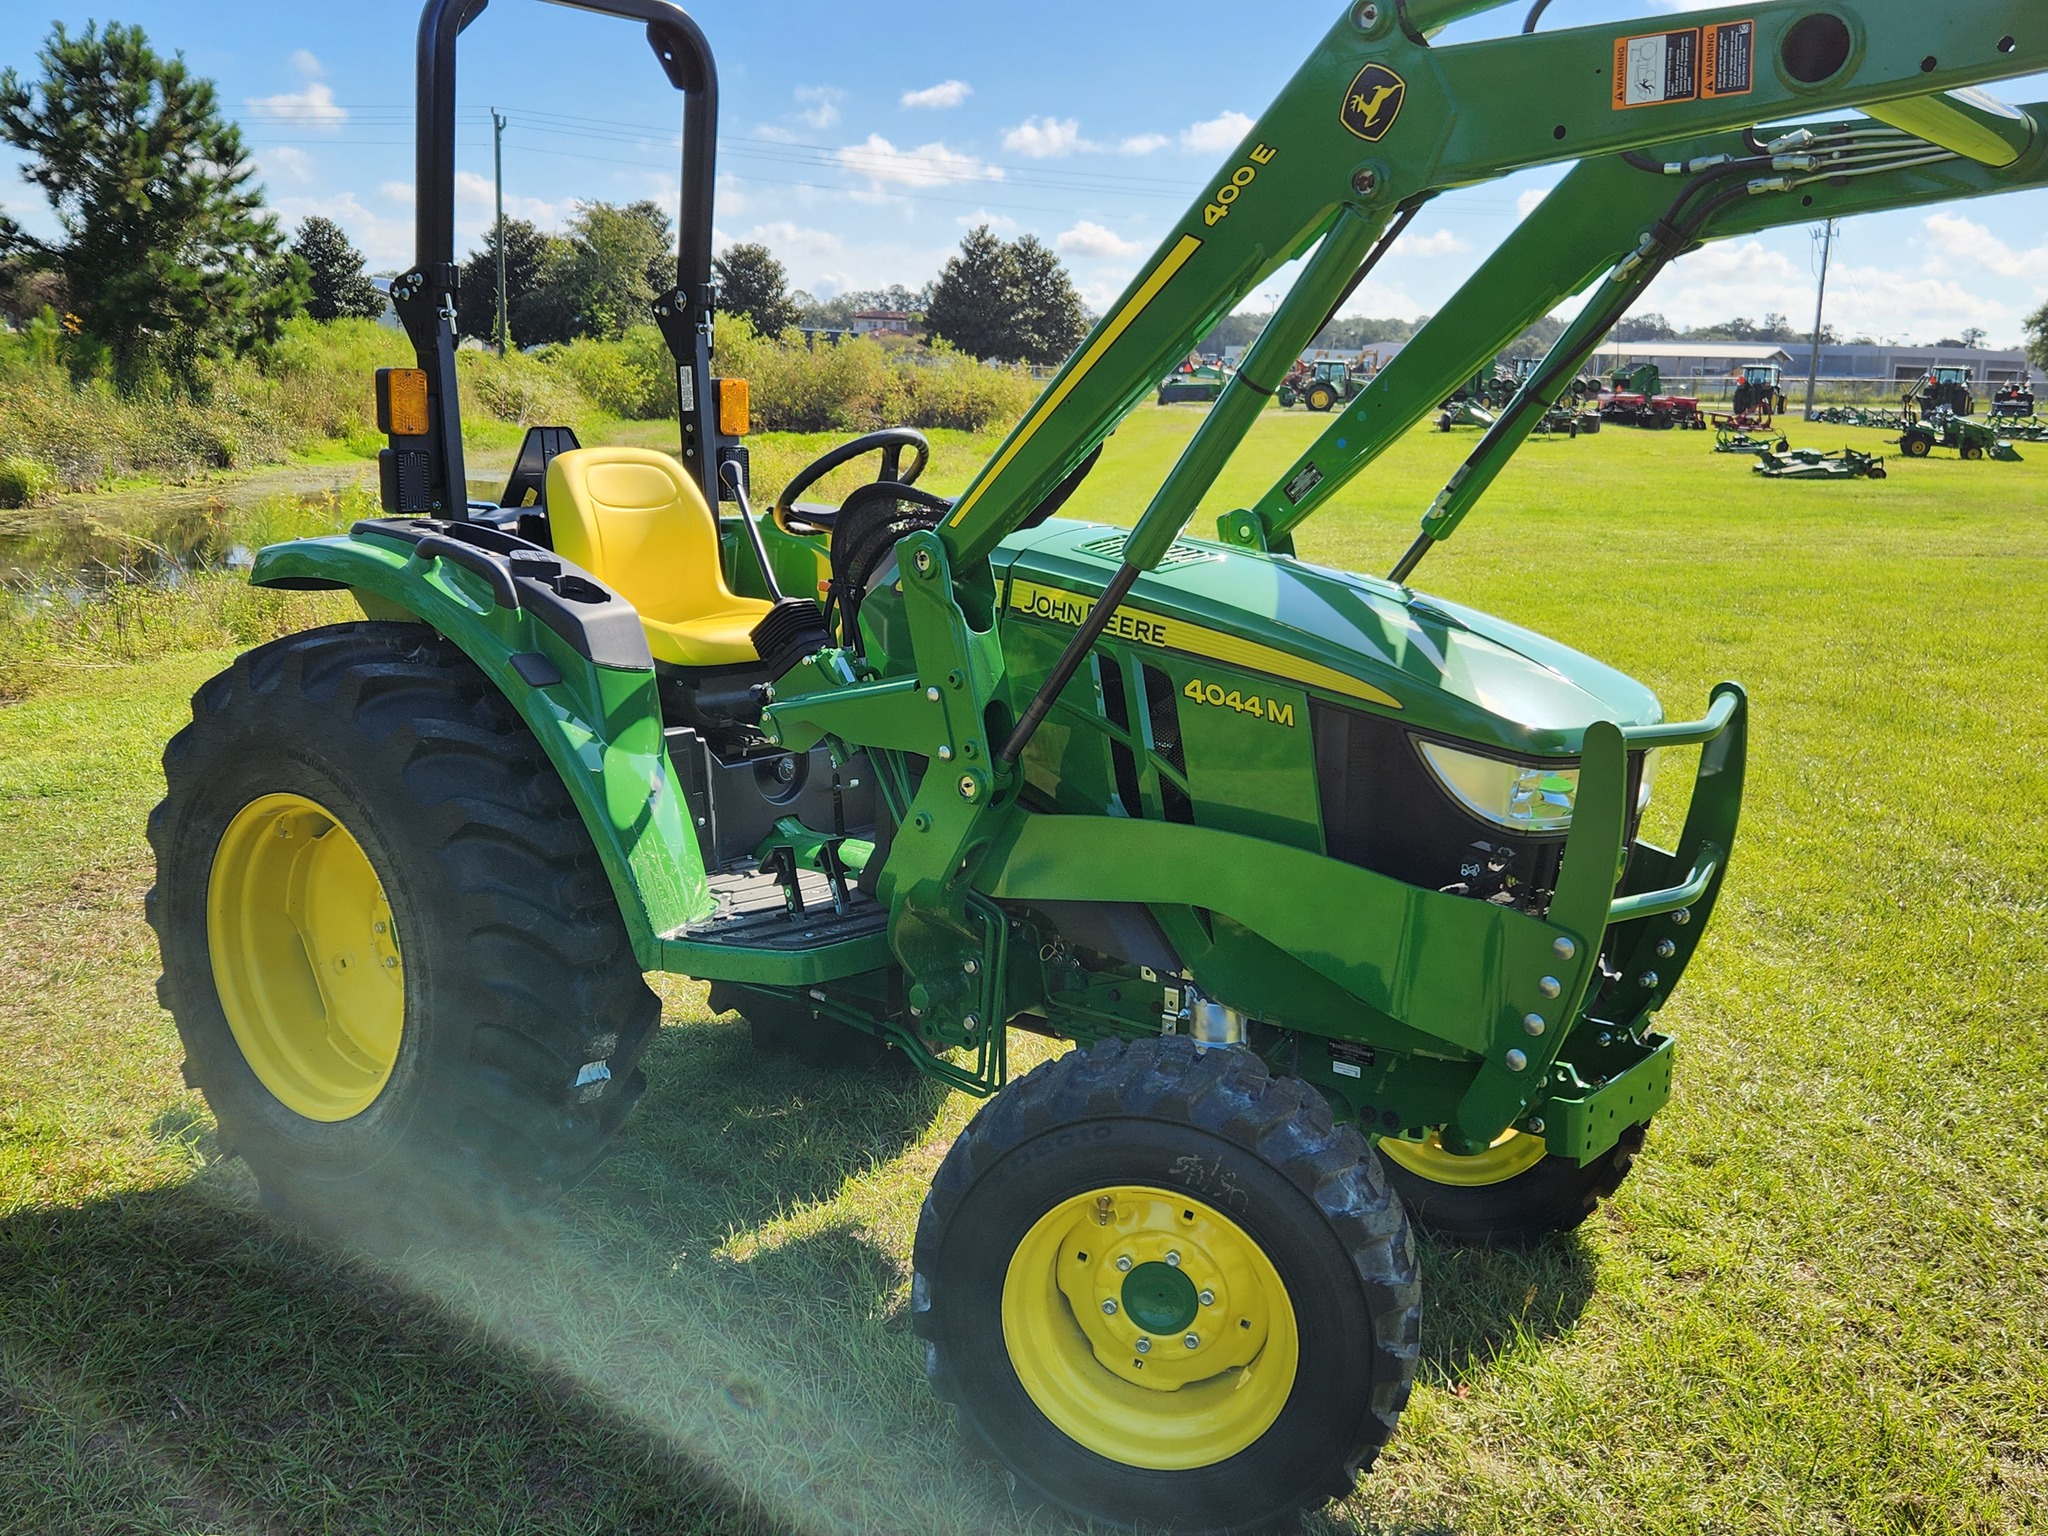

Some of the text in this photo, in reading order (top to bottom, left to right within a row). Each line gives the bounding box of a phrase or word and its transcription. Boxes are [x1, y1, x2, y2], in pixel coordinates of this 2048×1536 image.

[1616, 46, 1625, 90] WARNING
[1706, 32, 1715, 78] WARNING
[1023, 589, 1083, 623] JOHN
